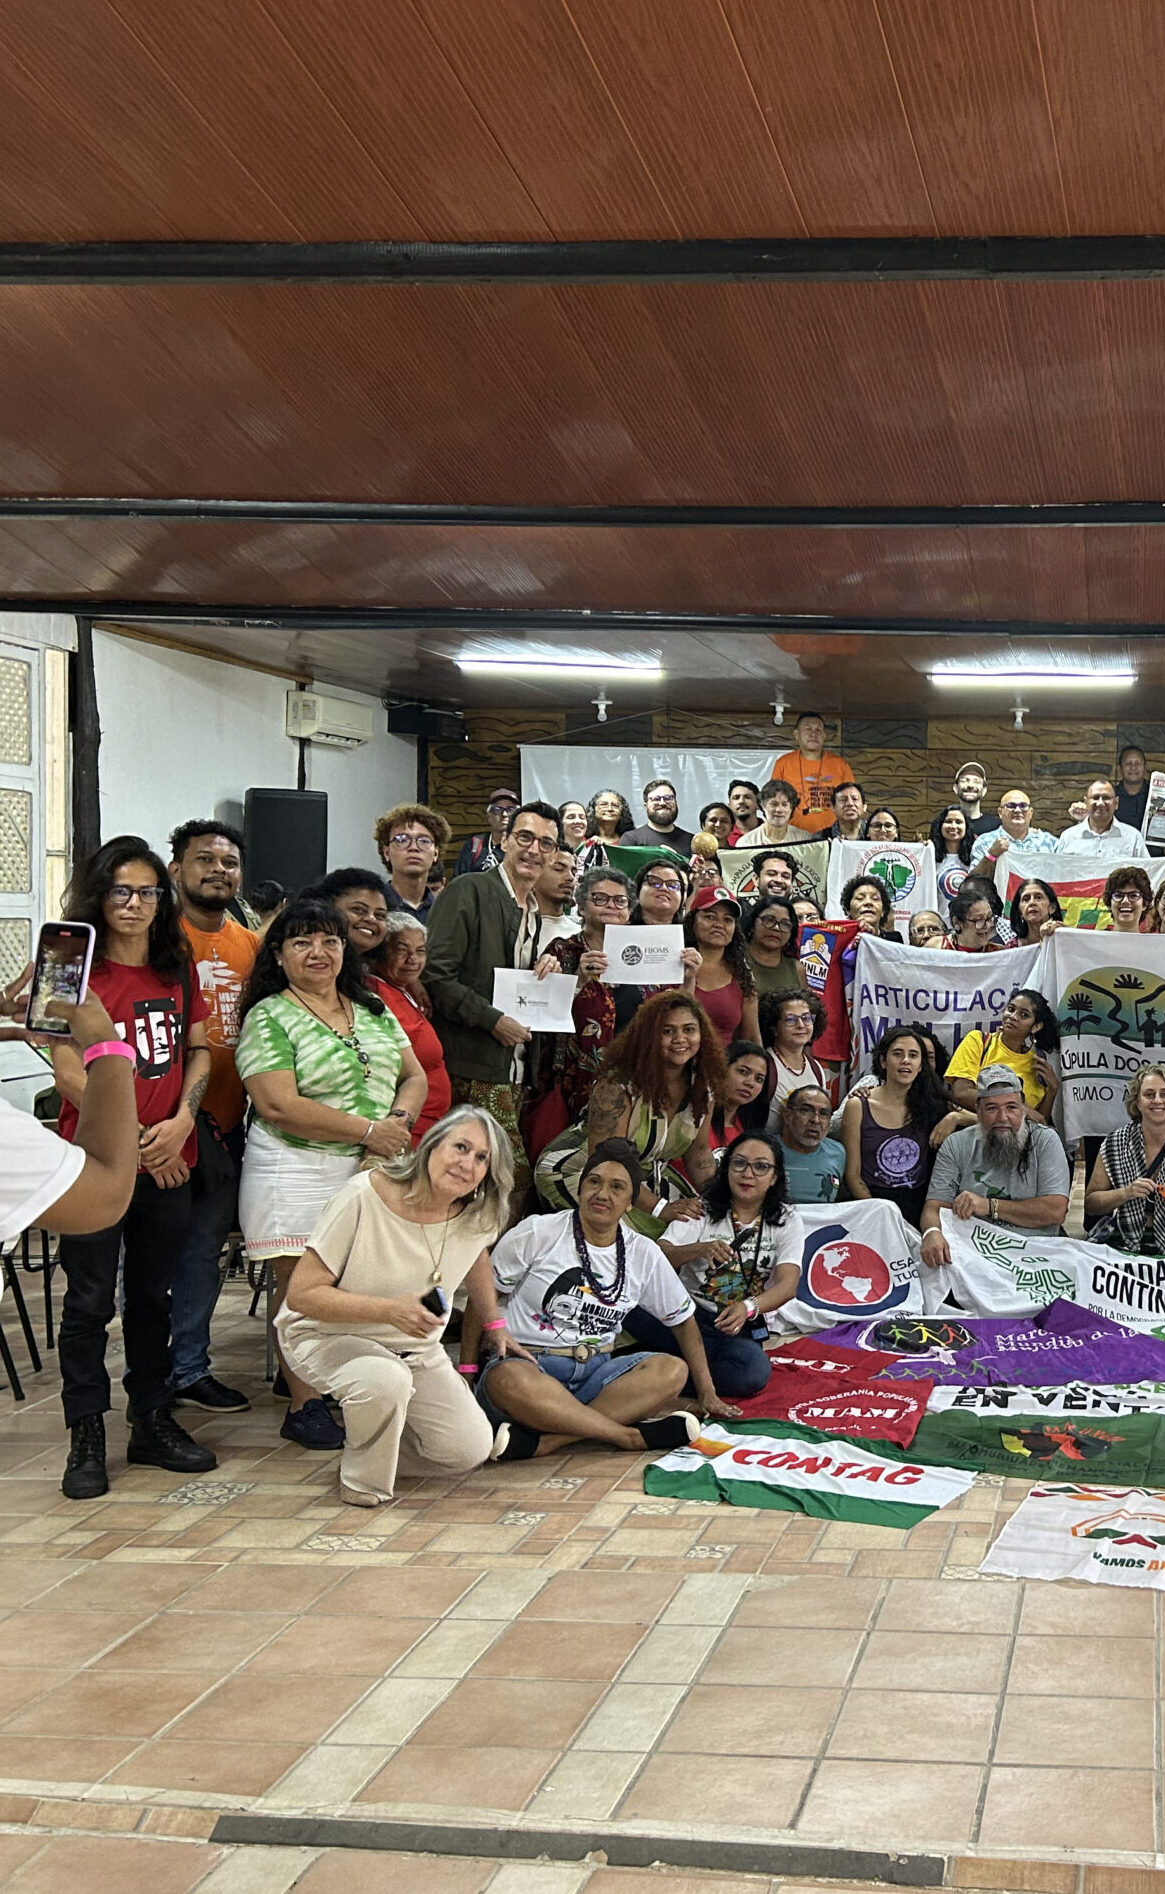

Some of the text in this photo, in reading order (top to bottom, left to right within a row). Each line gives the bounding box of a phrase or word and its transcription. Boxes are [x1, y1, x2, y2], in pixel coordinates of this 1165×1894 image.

[1061, 1049, 1109, 1071] ÚPULA
[1072, 1086, 1113, 1103] RUMO
[889, 1257, 914, 1271] CSA
[1104, 1306, 1115, 1320] LA
[995, 1328, 1048, 1343] Marc
[815, 1388, 875, 1403] SOBERANIA
[951, 1386, 1017, 1409] EN
[732, 1448, 925, 1486] CONTAG
[1092, 1552, 1146, 1569] VAMOS
